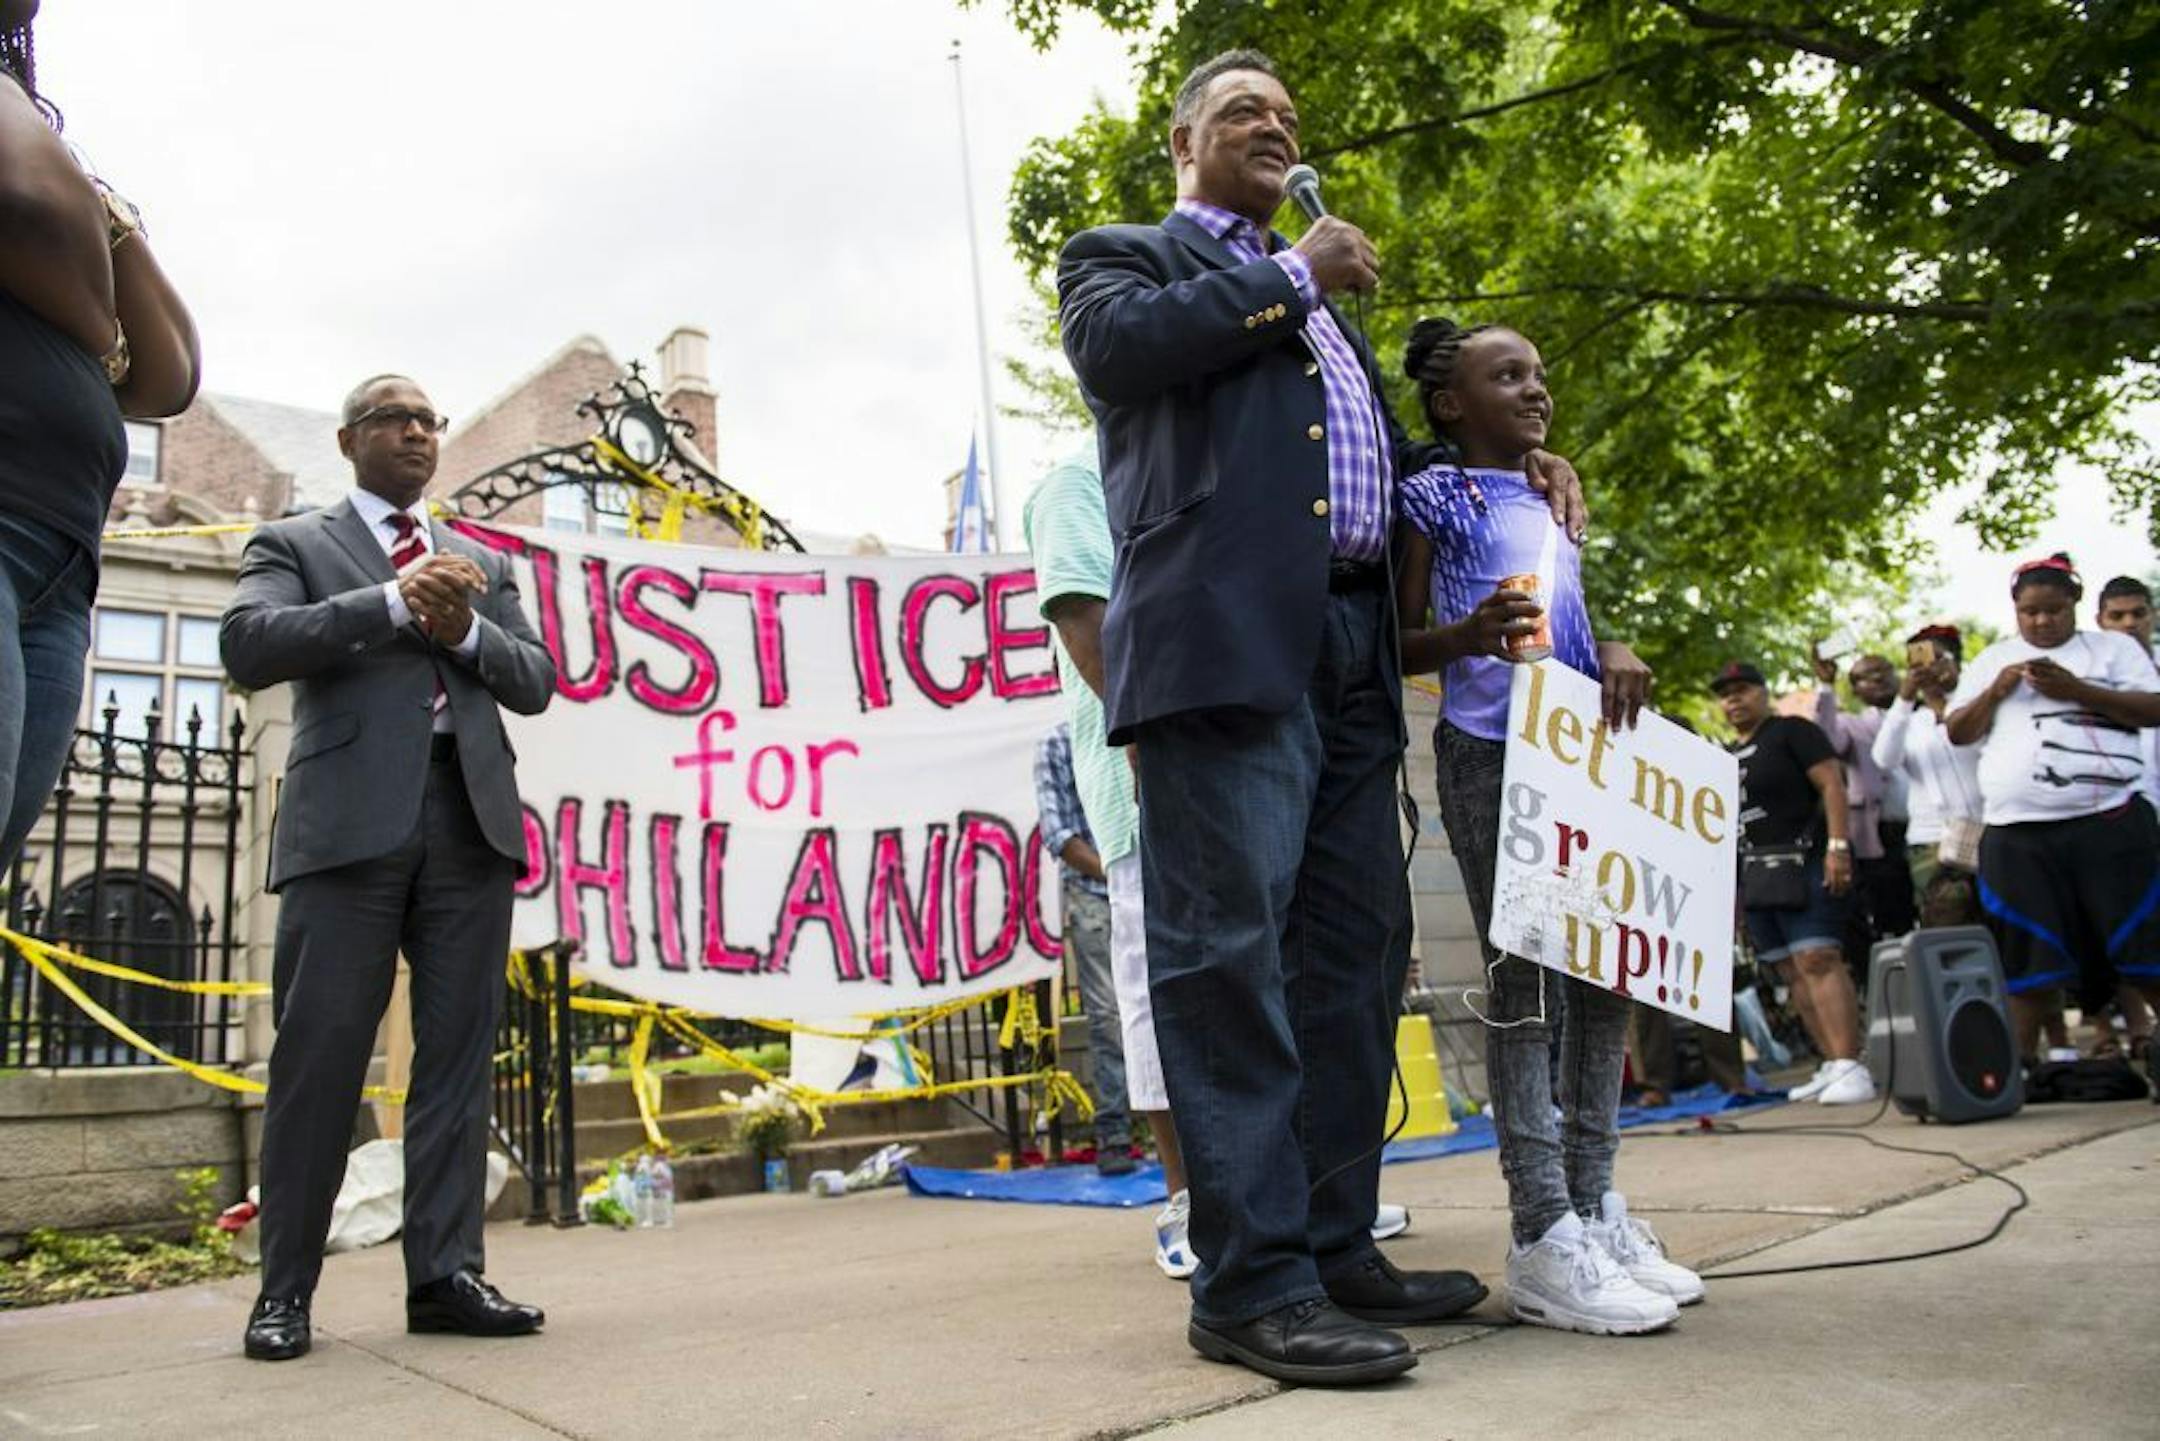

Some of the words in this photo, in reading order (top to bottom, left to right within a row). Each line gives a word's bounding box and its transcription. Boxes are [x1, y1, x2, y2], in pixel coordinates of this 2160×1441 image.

[445, 519, 1061, 715] USTICE
[674, 710, 860, 819] for
[1518, 662, 1616, 790] let
[1629, 752, 1726, 845] me
[1502, 781, 1693, 930] grow
[1564, 912, 1705, 1011] up!!!
